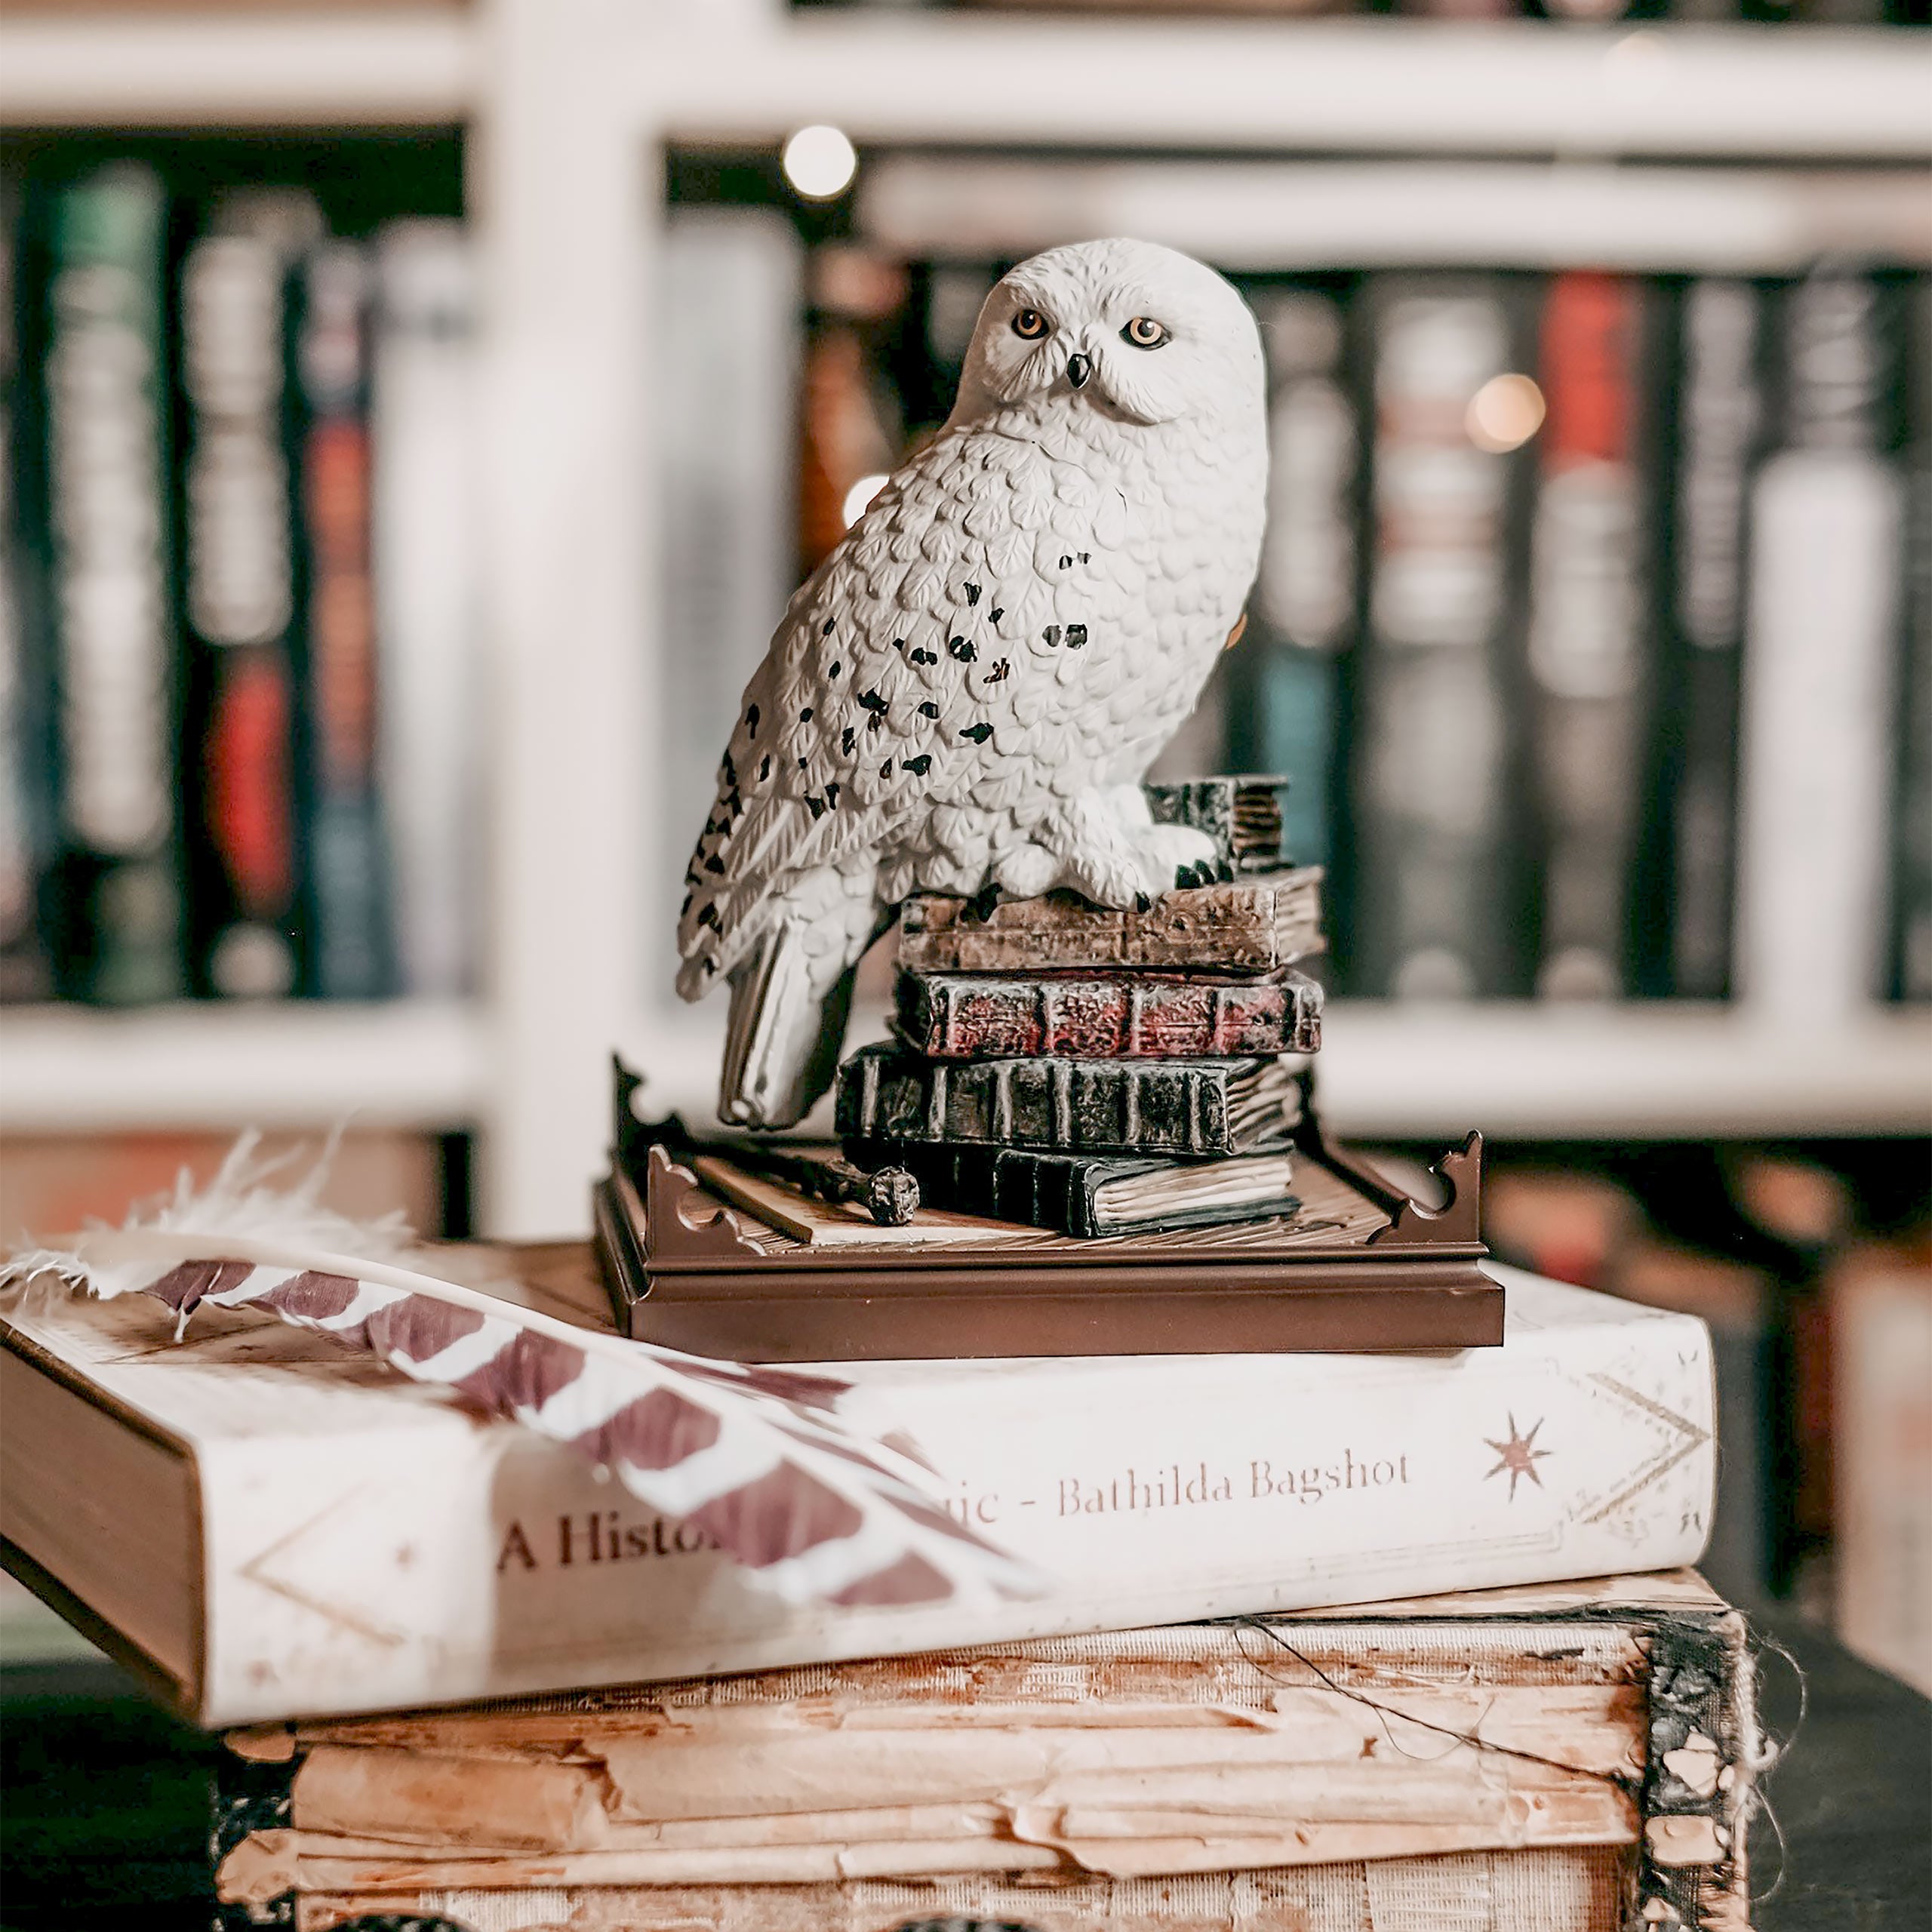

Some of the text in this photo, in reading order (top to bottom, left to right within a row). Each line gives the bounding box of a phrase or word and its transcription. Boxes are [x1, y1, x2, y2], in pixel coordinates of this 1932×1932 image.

[497, 1519, 538, 1573] A
[558, 1510, 721, 1567] Histo
[1058, 1462, 1232, 1517] Bathilda
[1250, 1447, 1410, 1505] Bagshot
